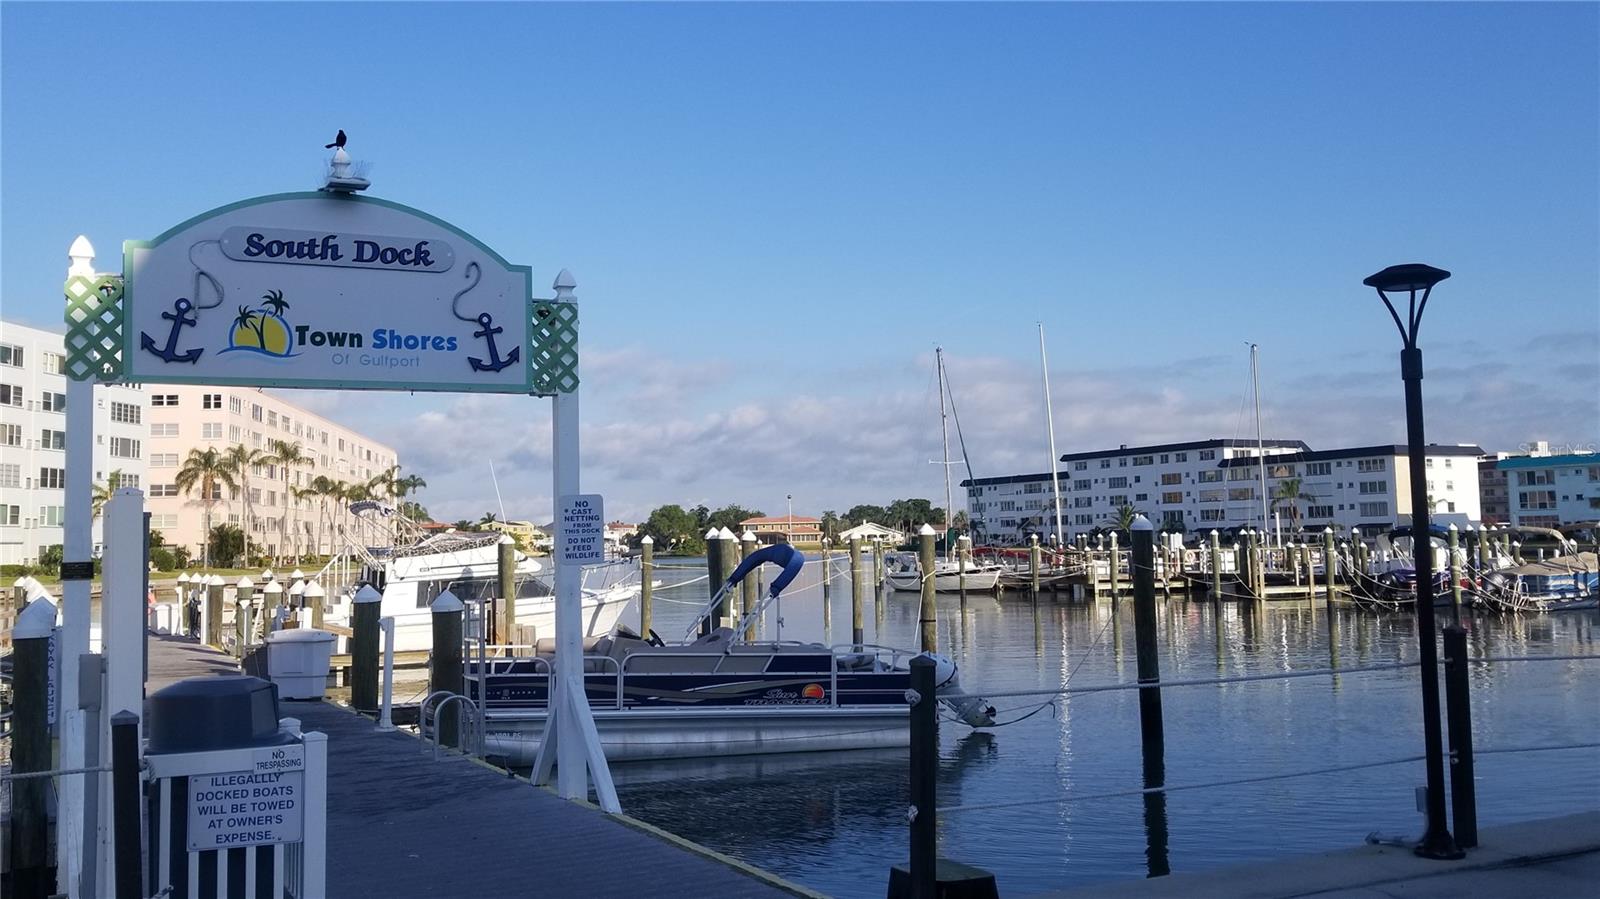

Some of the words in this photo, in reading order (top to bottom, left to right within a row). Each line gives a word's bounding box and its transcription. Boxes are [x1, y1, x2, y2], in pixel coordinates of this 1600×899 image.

[243, 233, 343, 261] South
[352, 240, 434, 267] Dock
[295, 325, 363, 348] Town
[372, 329, 458, 351] Shores
[332, 353, 349, 365] Of
[359, 354, 420, 368] Gulfport
[565, 552, 600, 560] WILDLIFE
[272, 751, 285, 759] NO
[256, 758, 302, 770] TRESPASSING
[196, 789, 250, 802] DOCKED
[252, 785, 294, 798] BOATS
[197, 805, 227, 816] WILL
[230, 803, 247, 814] BE
[250, 799, 295, 812] TOWED
[207, 818, 224, 829] AT
[226, 814, 284, 828] OWNER'S
[215, 830, 275, 844] EXPENSE.
